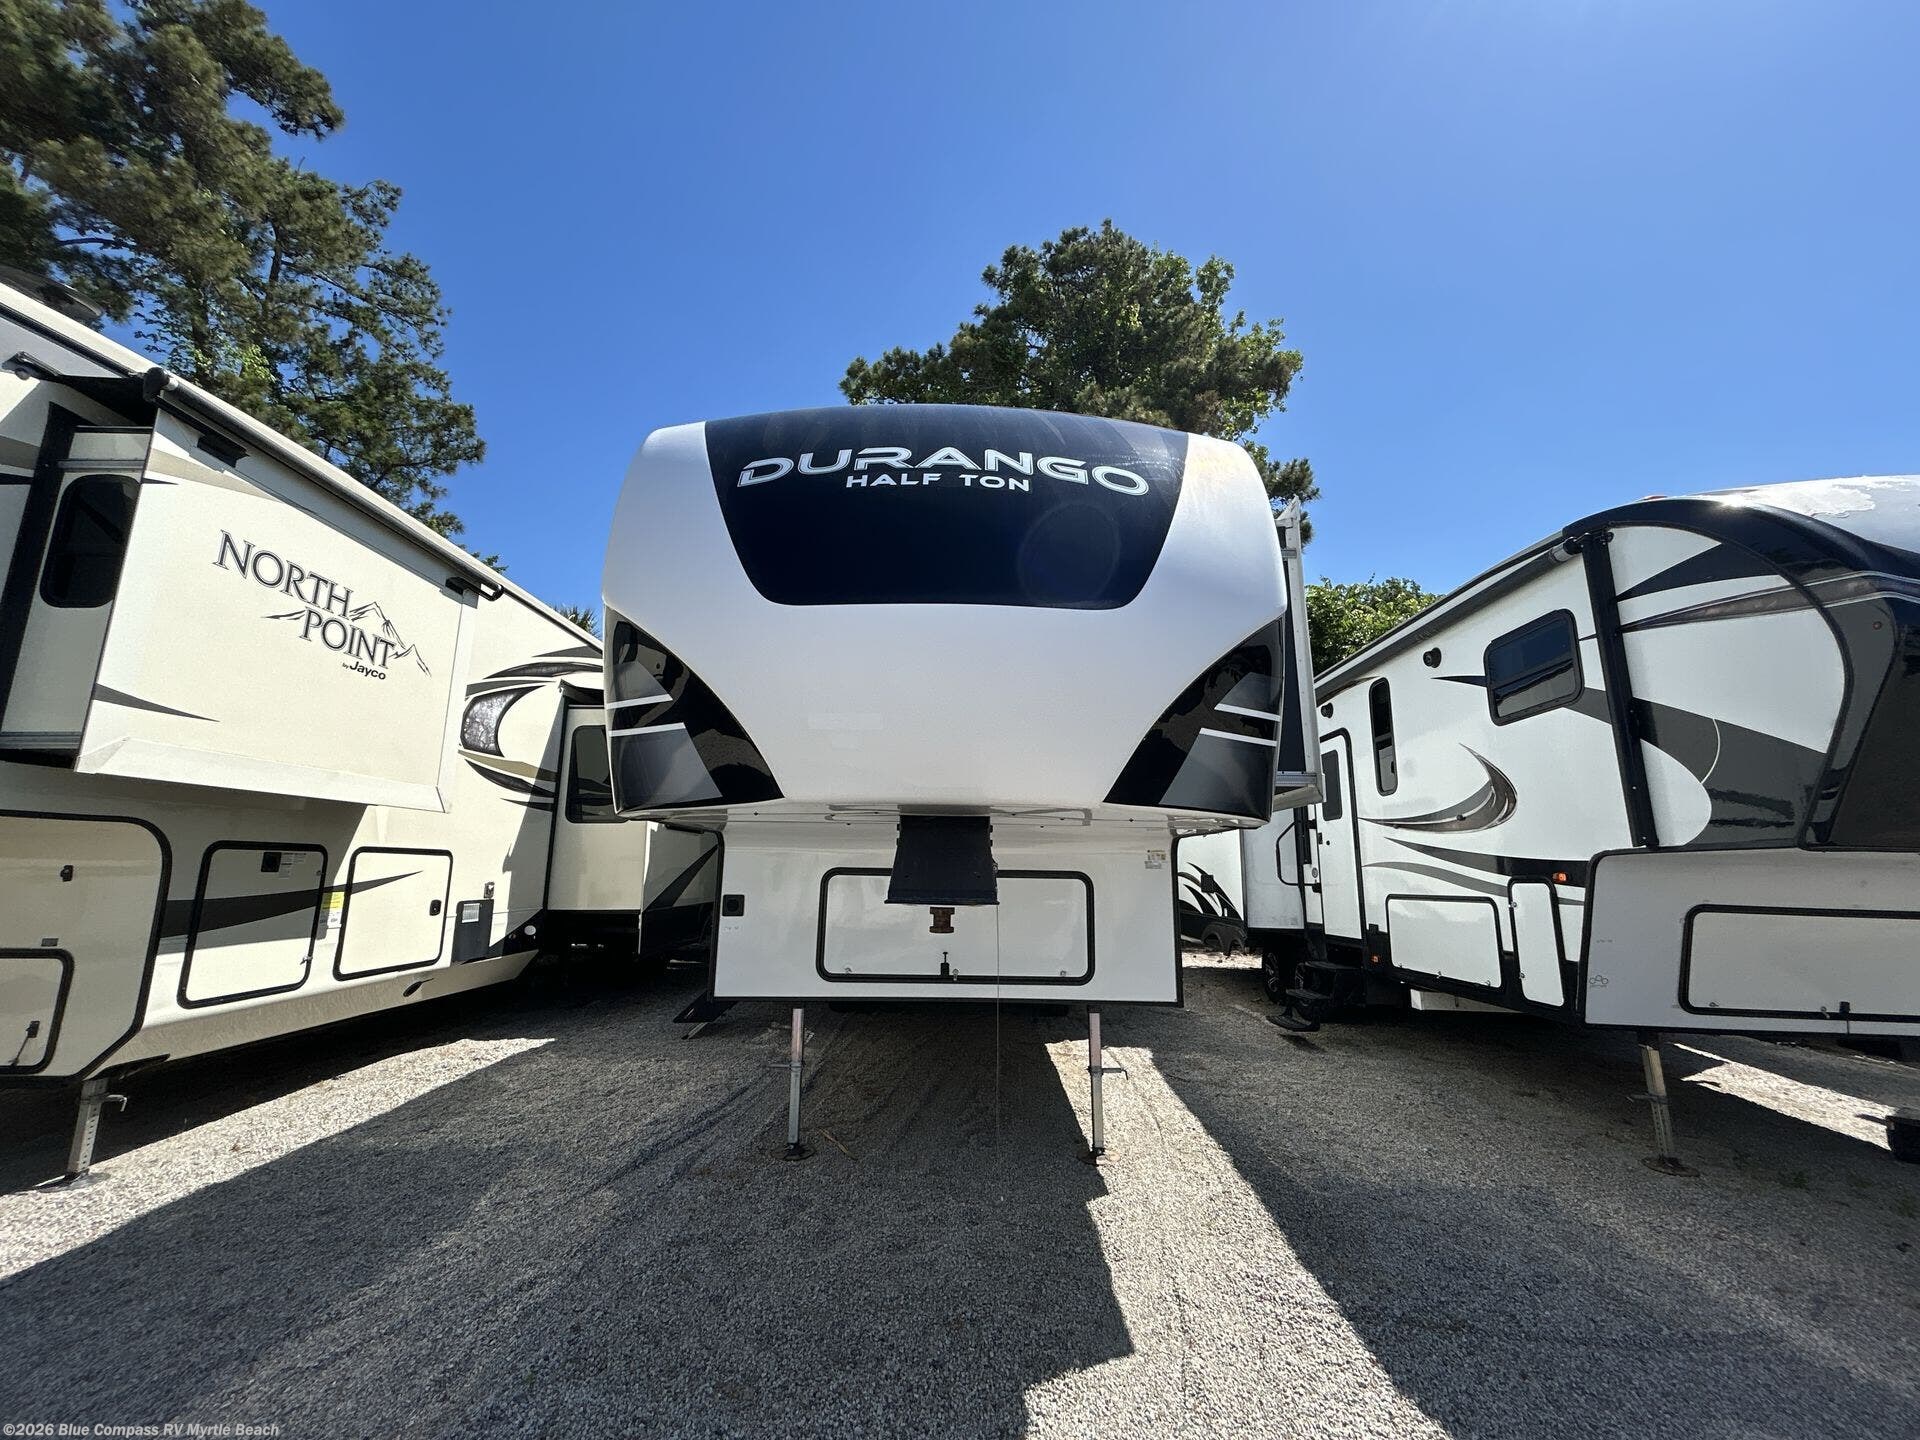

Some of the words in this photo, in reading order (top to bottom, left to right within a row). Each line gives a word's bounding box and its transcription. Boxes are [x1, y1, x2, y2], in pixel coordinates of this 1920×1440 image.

[737, 446, 1150, 496] DURANGO
[846, 473, 942, 488] HALF
[959, 474, 1030, 492] TON
[212, 529, 354, 621] NORTH
[299, 606, 396, 669] POINT
[350, 661, 386, 680] Jayco
